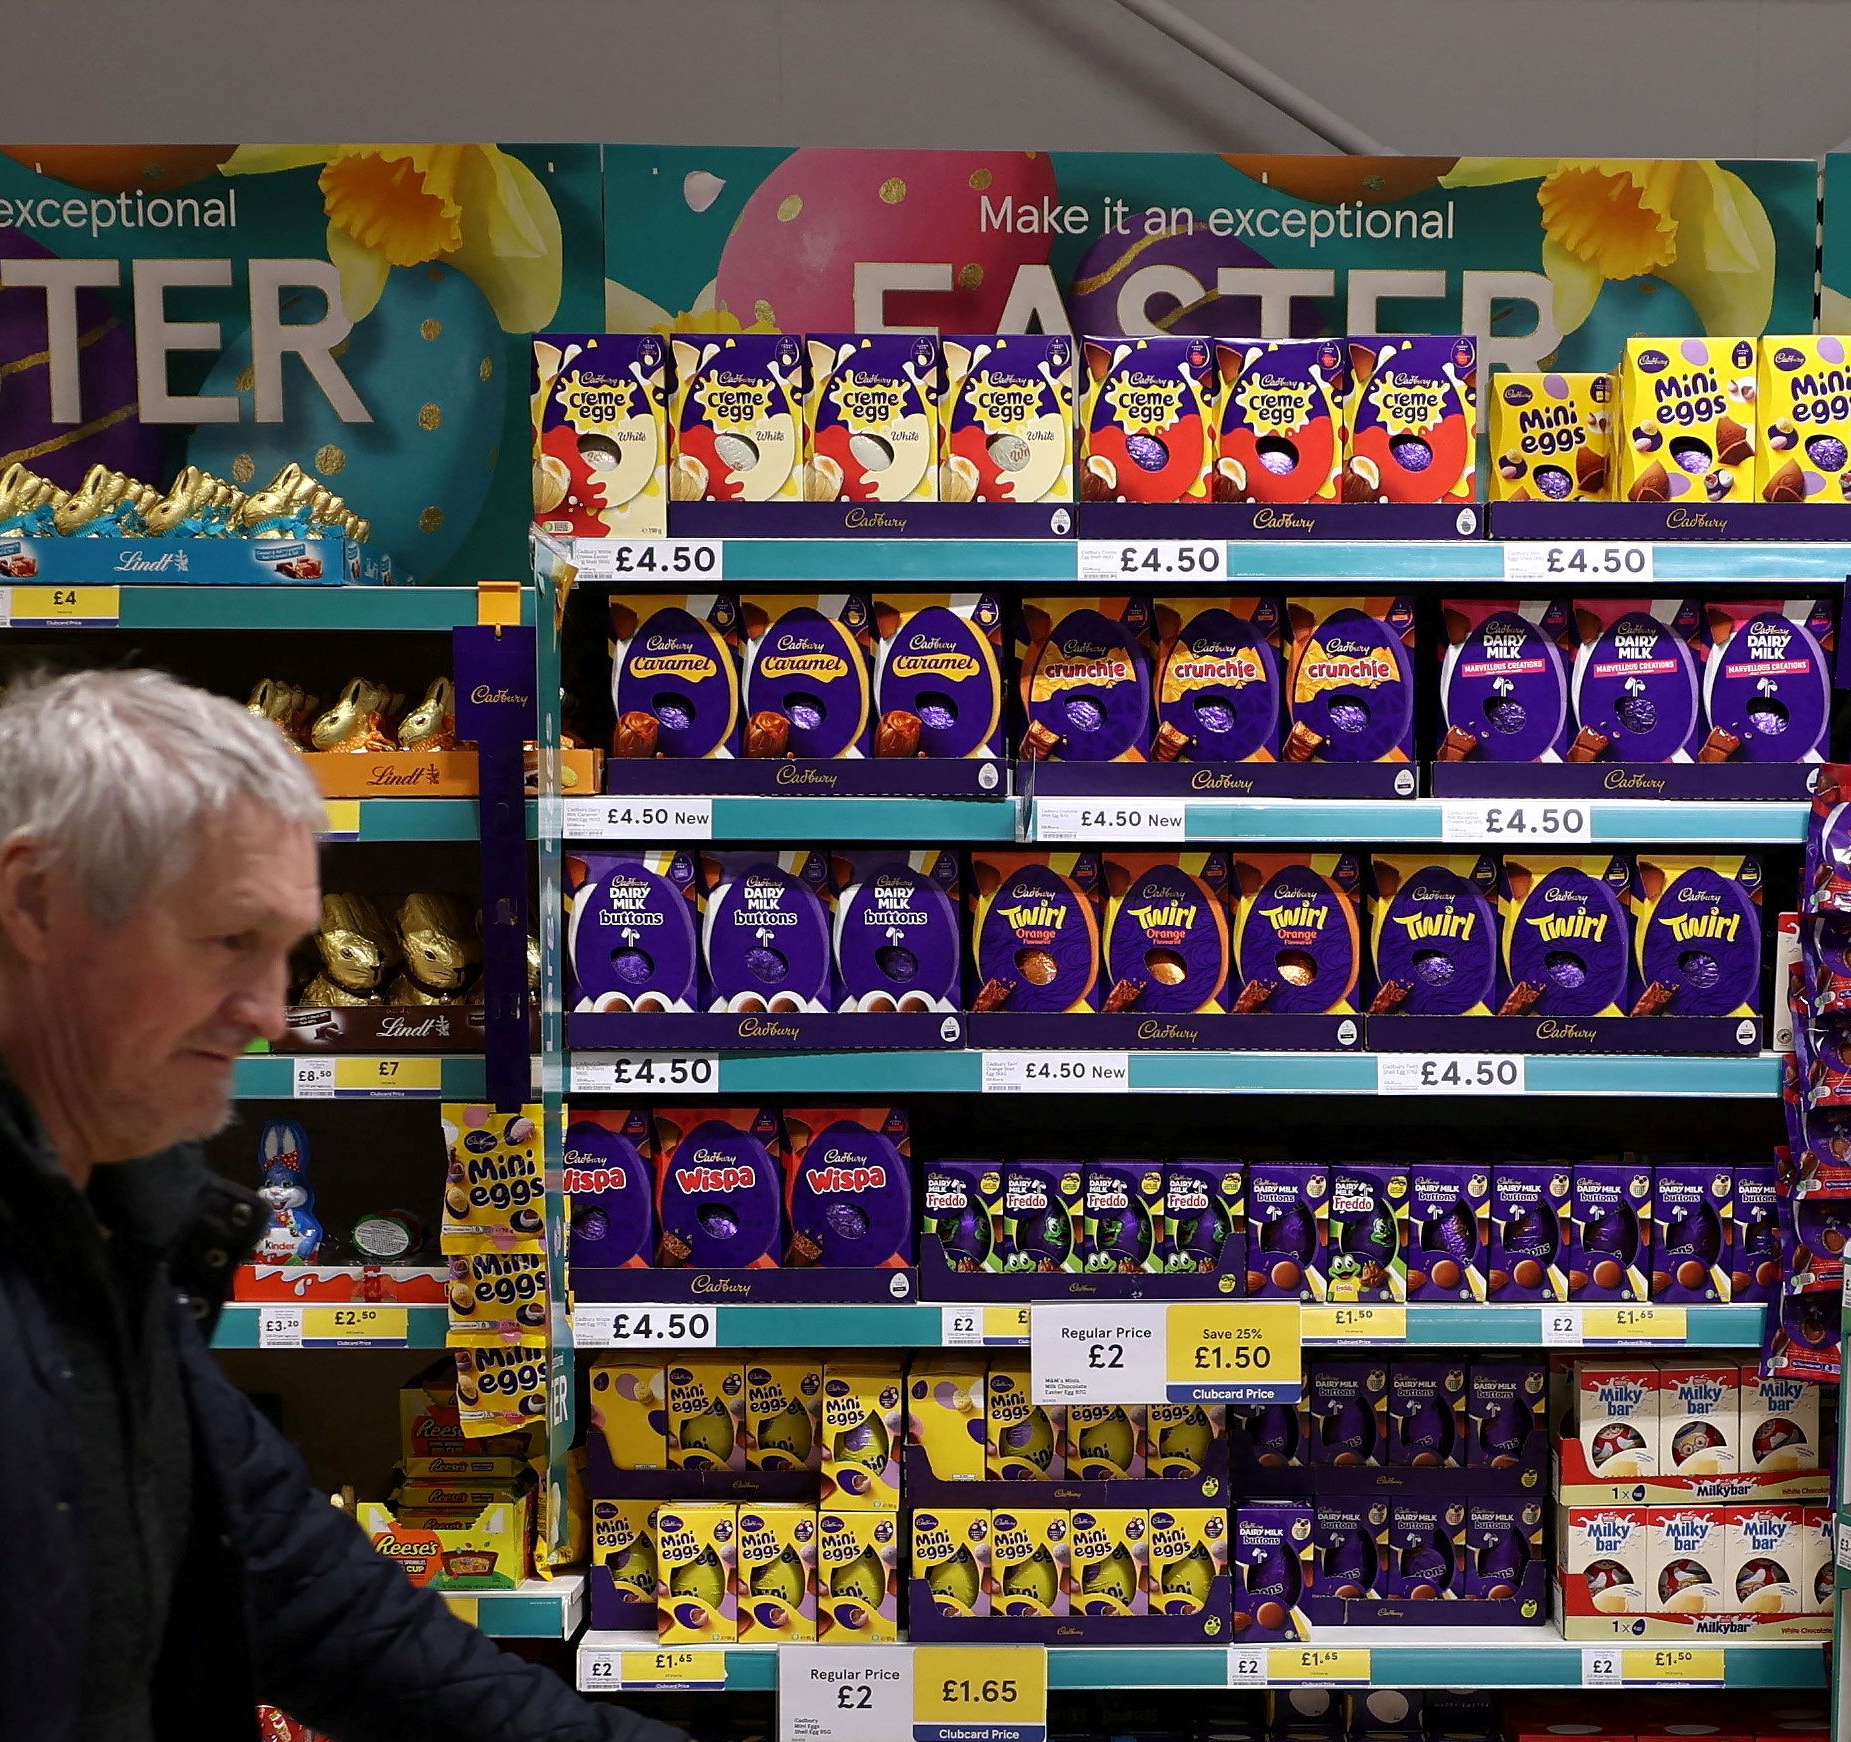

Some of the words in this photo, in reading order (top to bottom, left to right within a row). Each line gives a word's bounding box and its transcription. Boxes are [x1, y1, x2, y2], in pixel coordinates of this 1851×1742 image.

[980, 196, 1089, 235] Make
[1096, 199, 1130, 236] it
[1145, 211, 1196, 237] an
[1208, 200, 1454, 247] exceptional
[569, 390, 625, 409] creme
[1655, 375, 1717, 403] Mini
[579, 406, 615, 423] egg
[1656, 396, 1727, 424] eggs
[1666, 509, 1728, 532] Cadbury
[615, 546, 716, 574] £4.50
[1547, 548, 1646, 574] £4.50
[761, 657, 842, 672] Caramel
[1308, 661, 1390, 679] crunchie
[607, 808, 669, 827] £4.50
[675, 812, 709, 825] New
[1081, 809, 1143, 827] £4.50
[1147, 814, 1181, 827] New
[610, 887, 651, 900] DAIRY
[614, 898, 646, 910] MILK
[600, 910, 662, 926] buttons
[1393, 909, 1474, 941] Twirl
[1420, 1061, 1518, 1085] £4.50
[468, 1151, 536, 1182] Mini
[472, 1178, 546, 1205] eggs
[677, 1168, 754, 1191] Wispa
[612, 1313, 709, 1339] £4.50
[1202, 1327, 1232, 1339] Save
[1235, 1327, 1262, 1339] 25%
[1088, 1343, 1124, 1369] £2
[1195, 1345, 1271, 1369] £1.50
[1193, 1388, 1242, 1399] Clubcard
[1244, 1388, 1274, 1399] Price
[837, 1685, 873, 1710] £2
[942, 1680, 1017, 1704] £1.65
